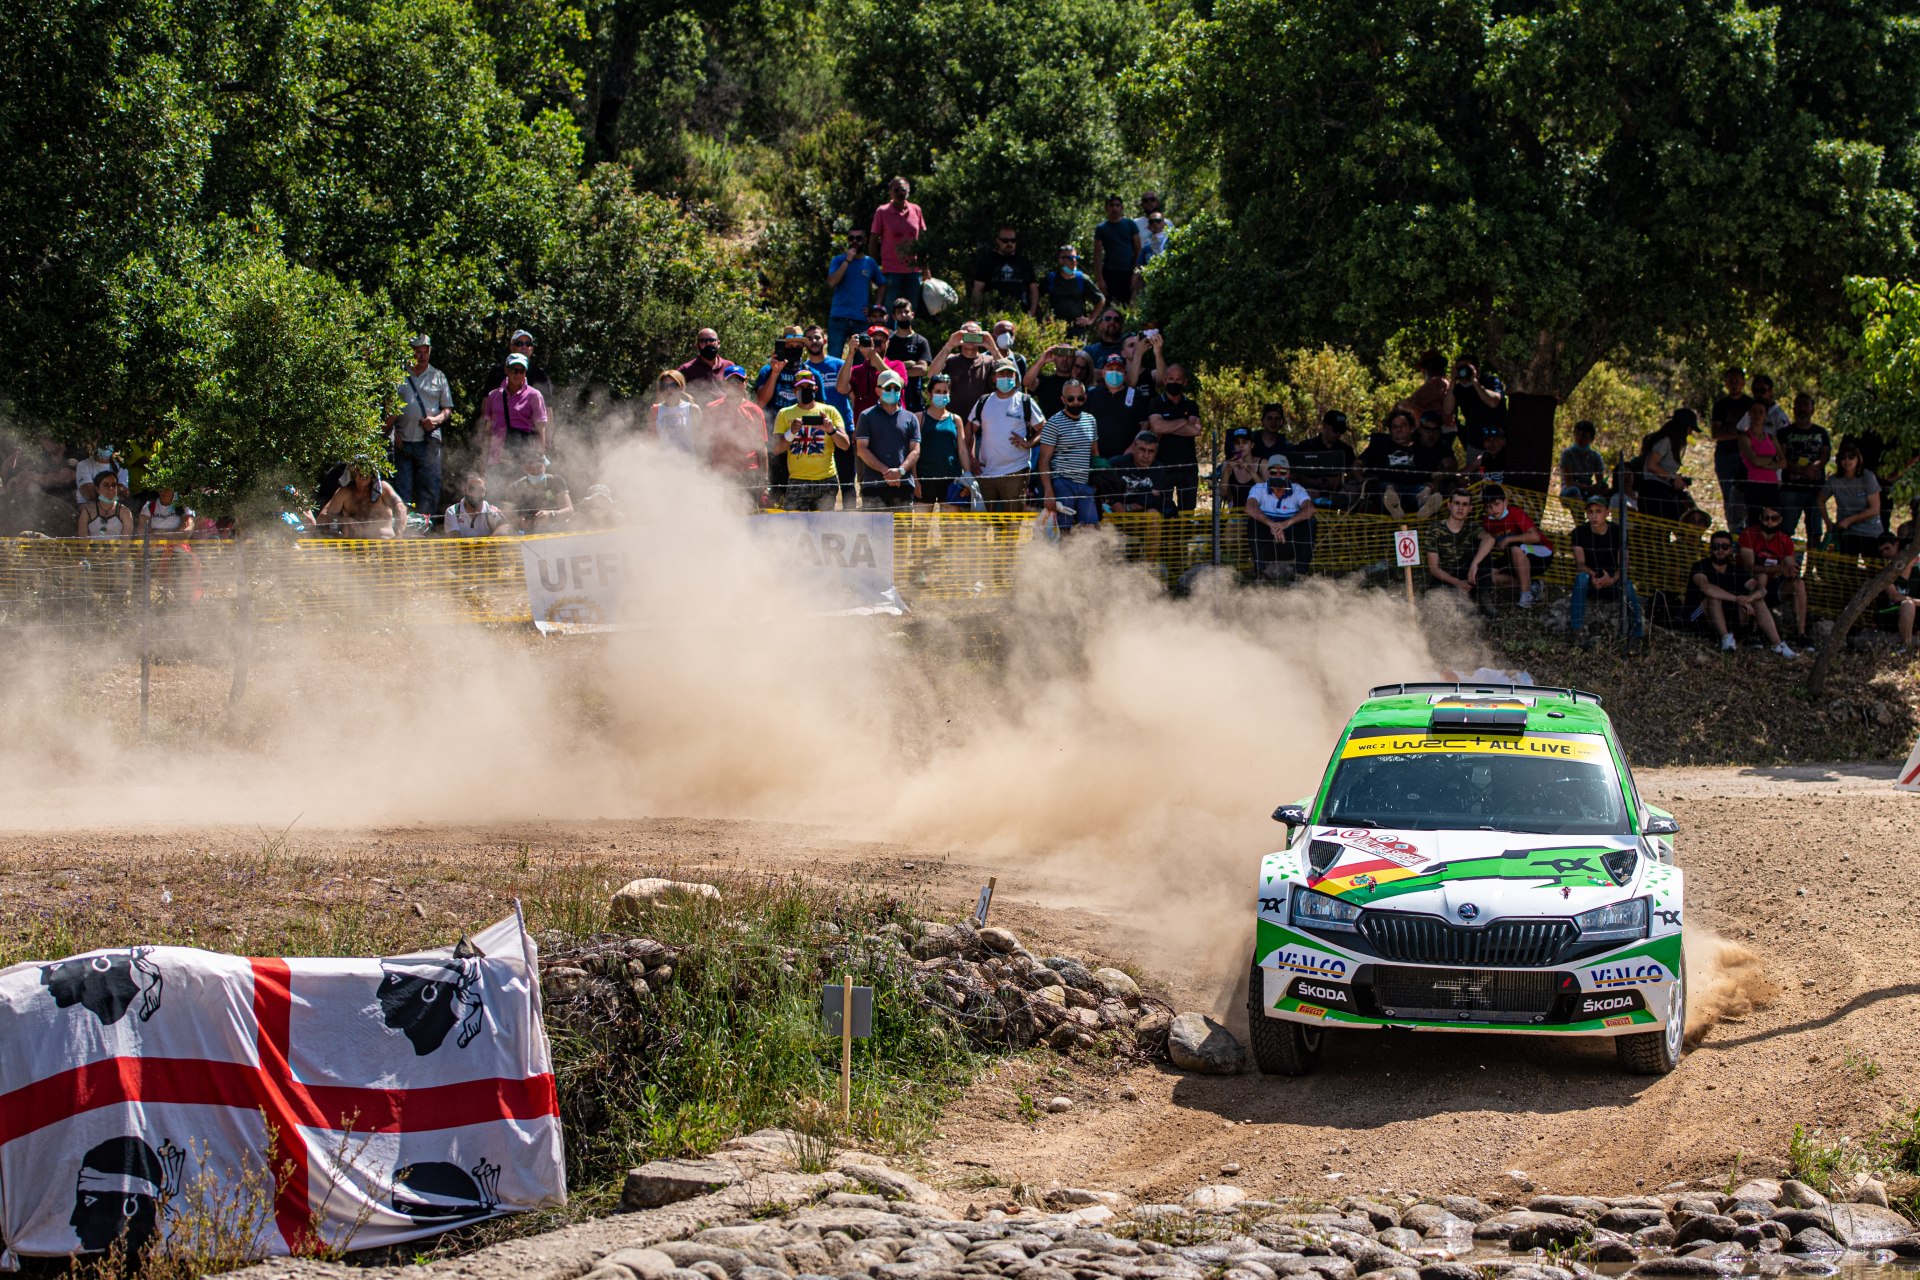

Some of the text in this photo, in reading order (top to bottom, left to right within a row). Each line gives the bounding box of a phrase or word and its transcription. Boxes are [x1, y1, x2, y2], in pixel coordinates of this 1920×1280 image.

[1358, 743, 1378, 751] WRC
[1489, 740, 1525, 751] ALL
[1530, 742, 1571, 755] LIVE
[1298, 981, 1348, 1002] ŠKODA
[1299, 1004, 1325, 1017] PIRELLI
[1583, 995, 1634, 1013] ŠKODA
[1604, 1017, 1631, 1027] PIRELLI
